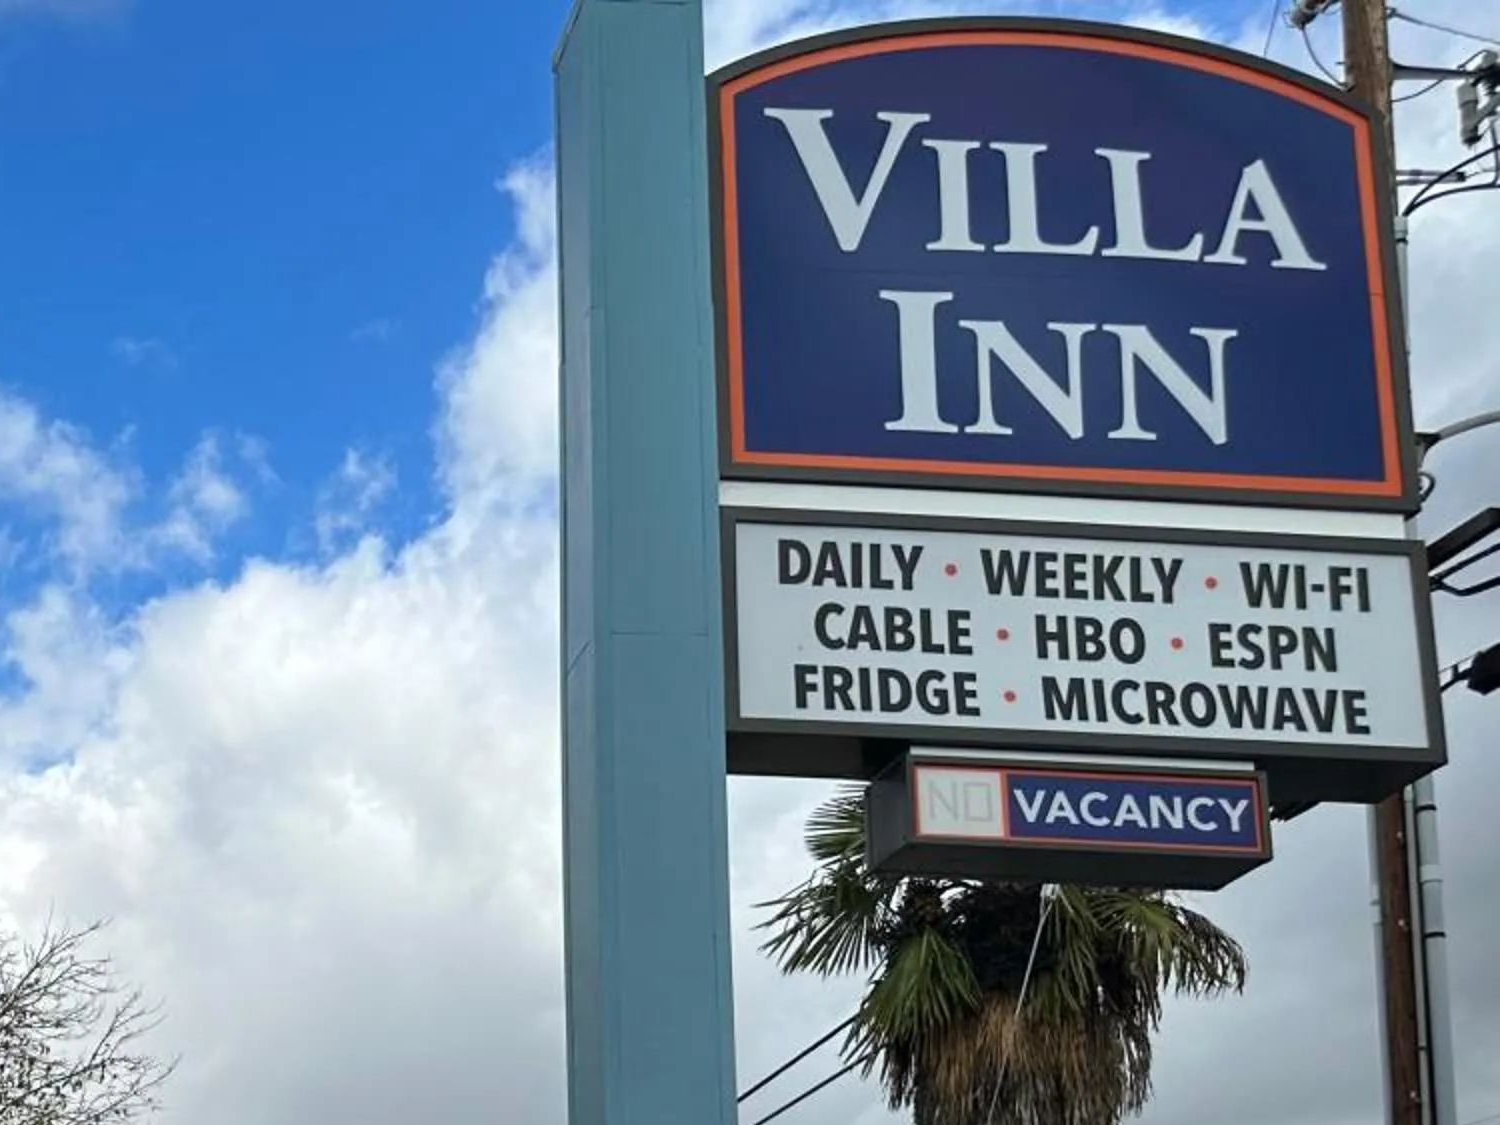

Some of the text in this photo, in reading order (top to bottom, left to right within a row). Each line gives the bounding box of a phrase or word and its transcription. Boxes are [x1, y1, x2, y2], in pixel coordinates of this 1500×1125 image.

[763, 107, 1327, 271] VILLA
[879, 289, 1238, 446] INN
[777, 539, 1372, 613] DAILY WEEKLY WI-FI
[814, 604, 1338, 673] CABLE HBO ESPN
[794, 664, 1372, 736] FRIDGE MICROWAVE
[928, 781, 1250, 832] NO VACANCY
